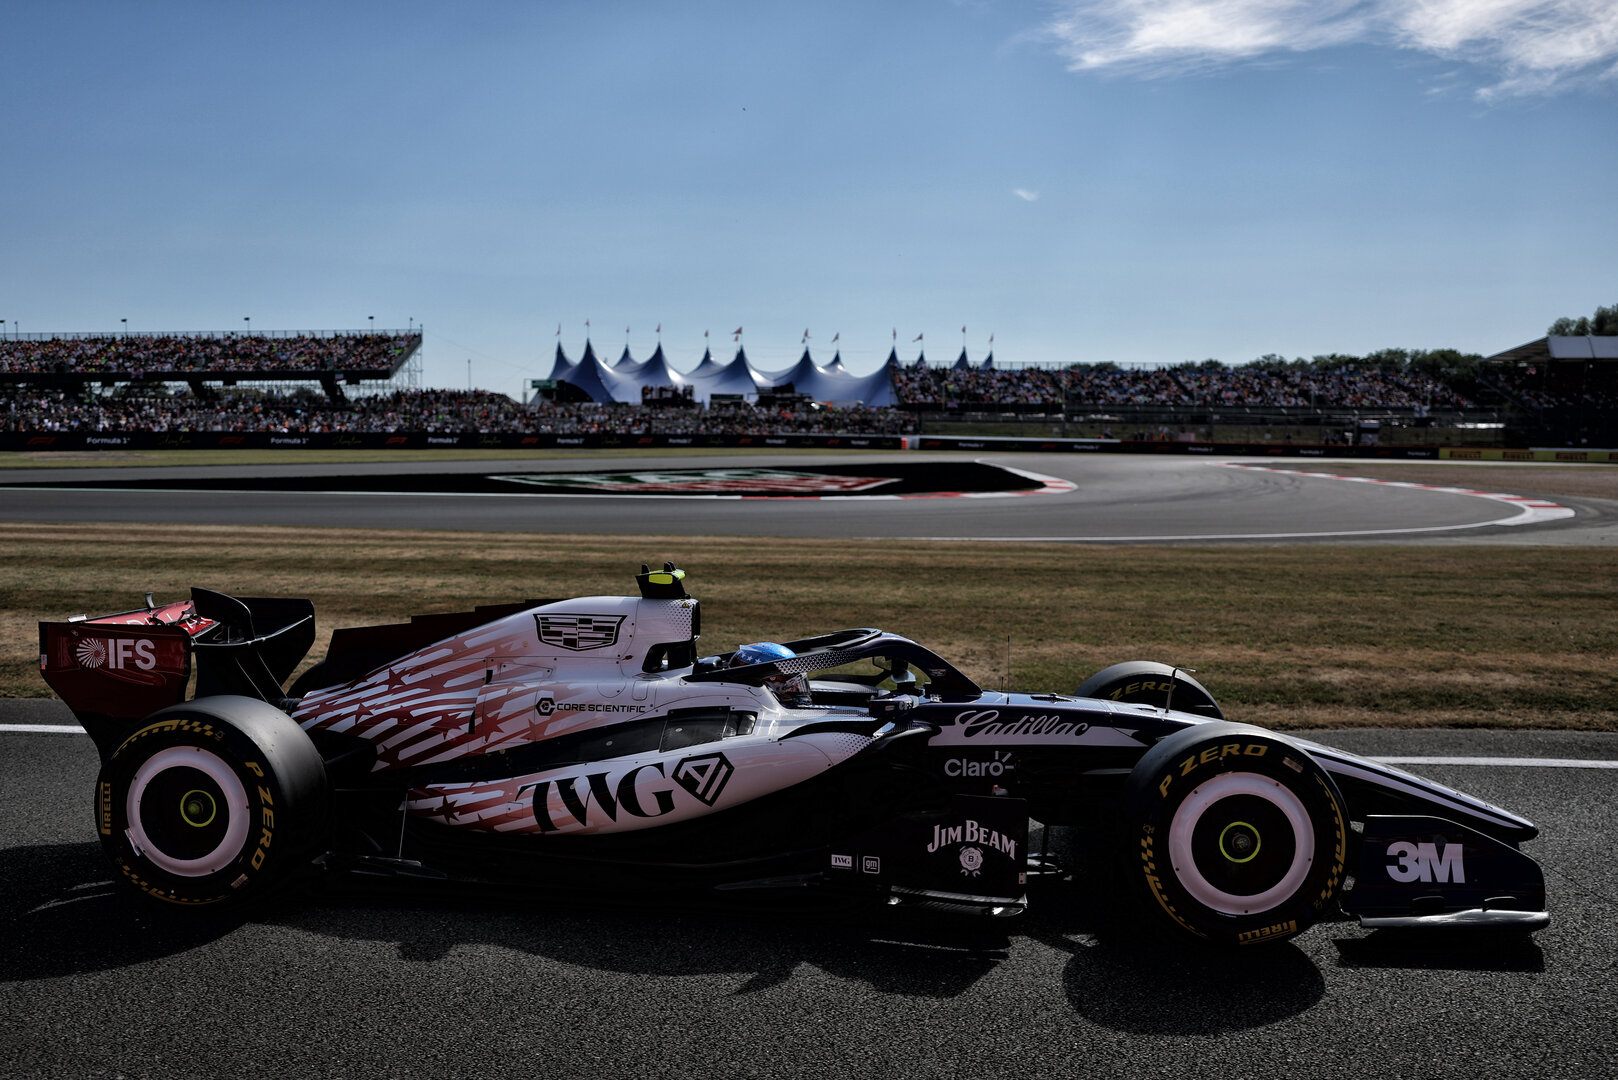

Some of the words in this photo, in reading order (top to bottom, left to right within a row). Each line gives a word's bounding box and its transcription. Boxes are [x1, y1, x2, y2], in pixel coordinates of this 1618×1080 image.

[86, 436, 122, 445] Formula
[270, 437, 302, 445] Formula
[109, 638, 156, 670] IFS
[1109, 681, 1177, 701] ZERO
[557, 703, 586, 711] CORE
[588, 704, 646, 713] SCIENTIFIC
[955, 710, 1089, 737] Cadillac
[244, 761, 264, 778] P
[944, 756, 1007, 777] Claro
[1158, 774, 1174, 799] P
[1179, 743, 1268, 777] ZERO
[100, 781, 112, 836] PIRELLI
[515, 762, 675, 832] TWG
[250, 784, 275, 871] ZERO
[927, 824, 962, 853] JIM
[965, 819, 1016, 861] BEAM
[865, 860, 878, 870] gm
[1385, 841, 1466, 884] 3M
[1238, 919, 1298, 946] PIRELLI
